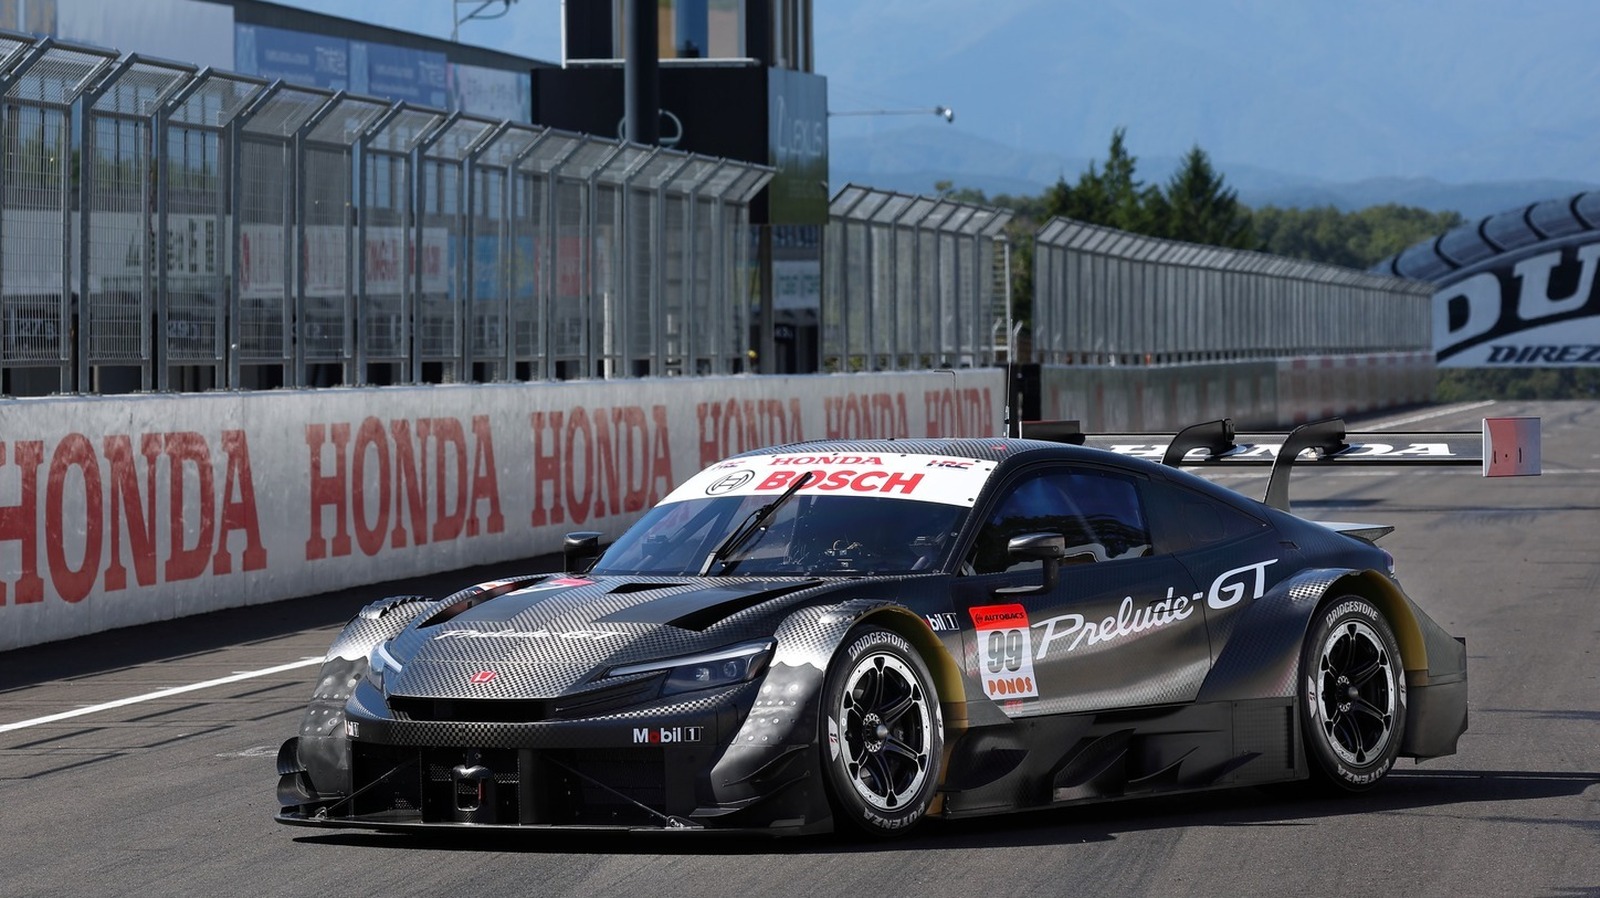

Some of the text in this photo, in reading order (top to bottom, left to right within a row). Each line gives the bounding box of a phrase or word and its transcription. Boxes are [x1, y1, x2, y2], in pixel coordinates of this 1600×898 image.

[1487, 344, 1600, 363] DIREZ
[825, 393, 907, 439] HONDA
[925, 388, 993, 438] HONDA
[698, 398, 803, 470] HONDA
[531, 403, 674, 528] HONDA
[767, 453, 884, 467] HONDA
[305, 414, 505, 561] HONDA
[755, 469, 925, 495] BOSCH
[0, 429, 267, 607] HONDA
[924, 613, 947, 631] bil
[983, 611, 1025, 622] AUTOBACS
[1325, 600, 1379, 629] BRIDGESTONE
[847, 631, 910, 662] BRIDGESTONE
[987, 628, 1024, 674] 99
[987, 676, 1033, 696] PONOS
[633, 727, 681, 744] Mobil
[1337, 757, 1390, 785] POTENZA
[863, 800, 926, 830] POTENZA
